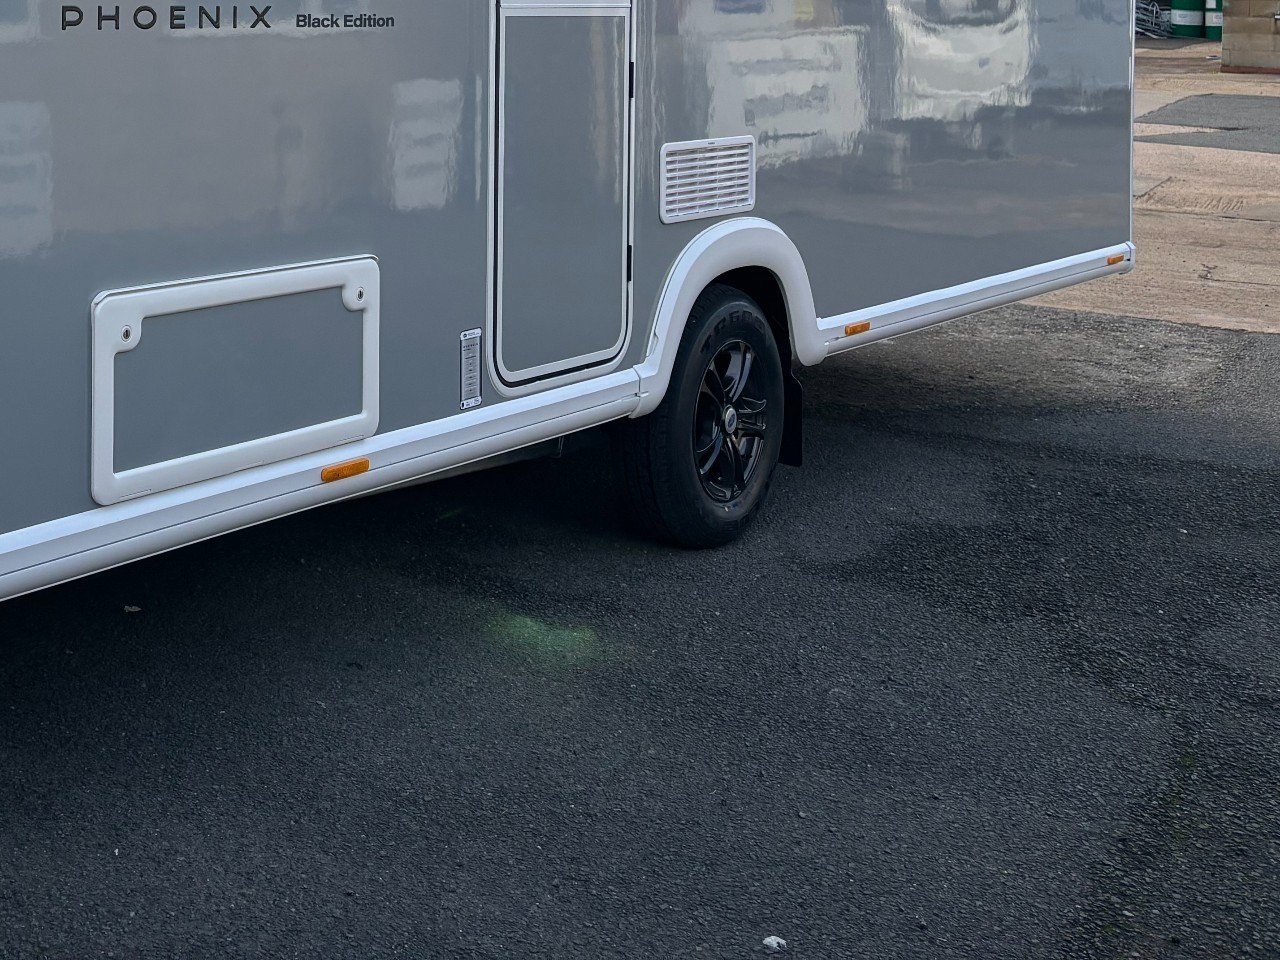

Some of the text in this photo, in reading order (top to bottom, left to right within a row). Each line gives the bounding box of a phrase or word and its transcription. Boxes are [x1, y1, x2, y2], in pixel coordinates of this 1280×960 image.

[61, 5, 395, 30] PHOENIX Black Edition
